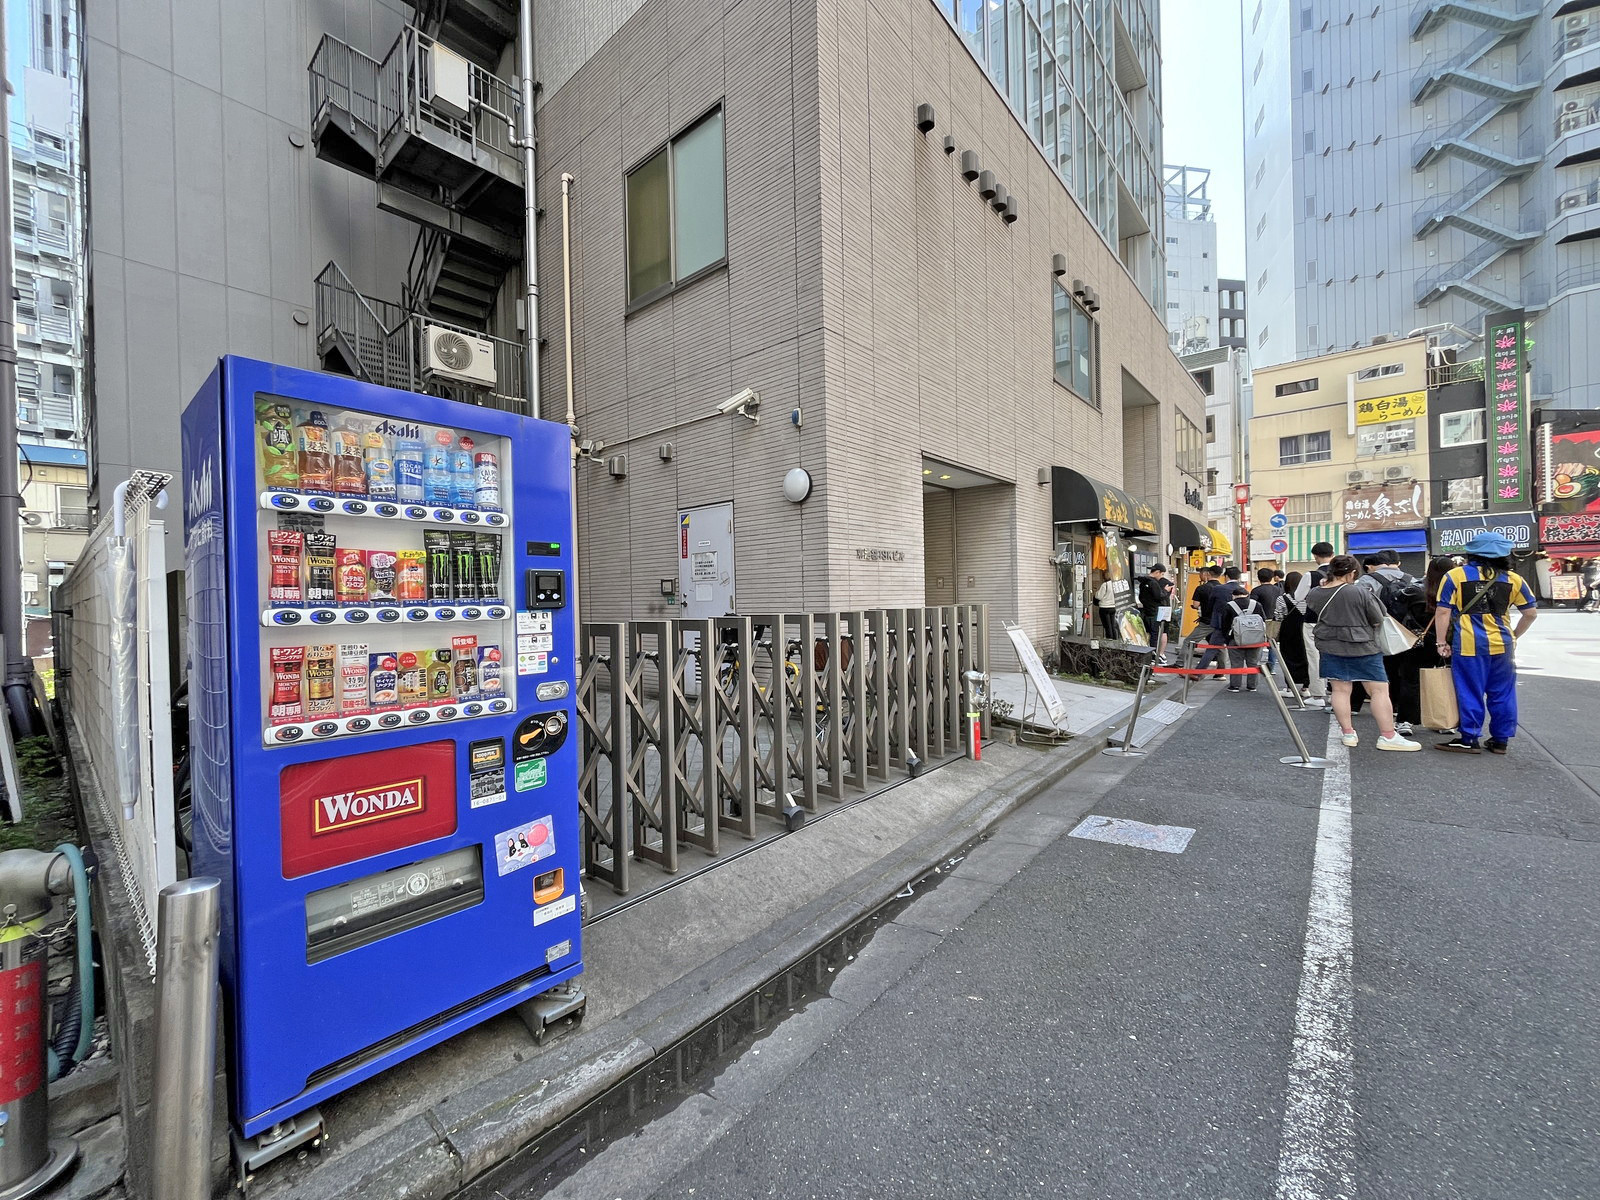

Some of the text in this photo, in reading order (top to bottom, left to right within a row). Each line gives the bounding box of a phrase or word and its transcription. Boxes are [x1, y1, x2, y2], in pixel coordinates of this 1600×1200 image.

[1497, 370, 1517, 378] weed
[1358, 397, 1408, 413] 鶏白湯
[1380, 405, 1426, 421] らーめん
[1496, 413, 1518, 421] ganja
[374, 419, 420, 439] Asahi
[306, 441, 328, 452] 麦茶
[342, 445, 362, 456] 麦茶
[189, 454, 212, 521] Asahi
[1345, 499, 1370, 510] 鶏白湯
[1345, 511, 1371, 520] らーめん
[272, 555, 299, 564] WONDA
[309, 556, 335, 565] WONDA
[270, 588, 301, 599] 朝専用
[308, 588, 334, 599] 朝専用
[272, 648, 303, 656] 新・ワンダ
[275, 672, 300, 681] WONDA
[308, 668, 333, 677] WONDA
[343, 667, 367, 675] WONDA
[271, 704, 301, 717] 朝専用
[321, 787, 416, 824] WONDA
